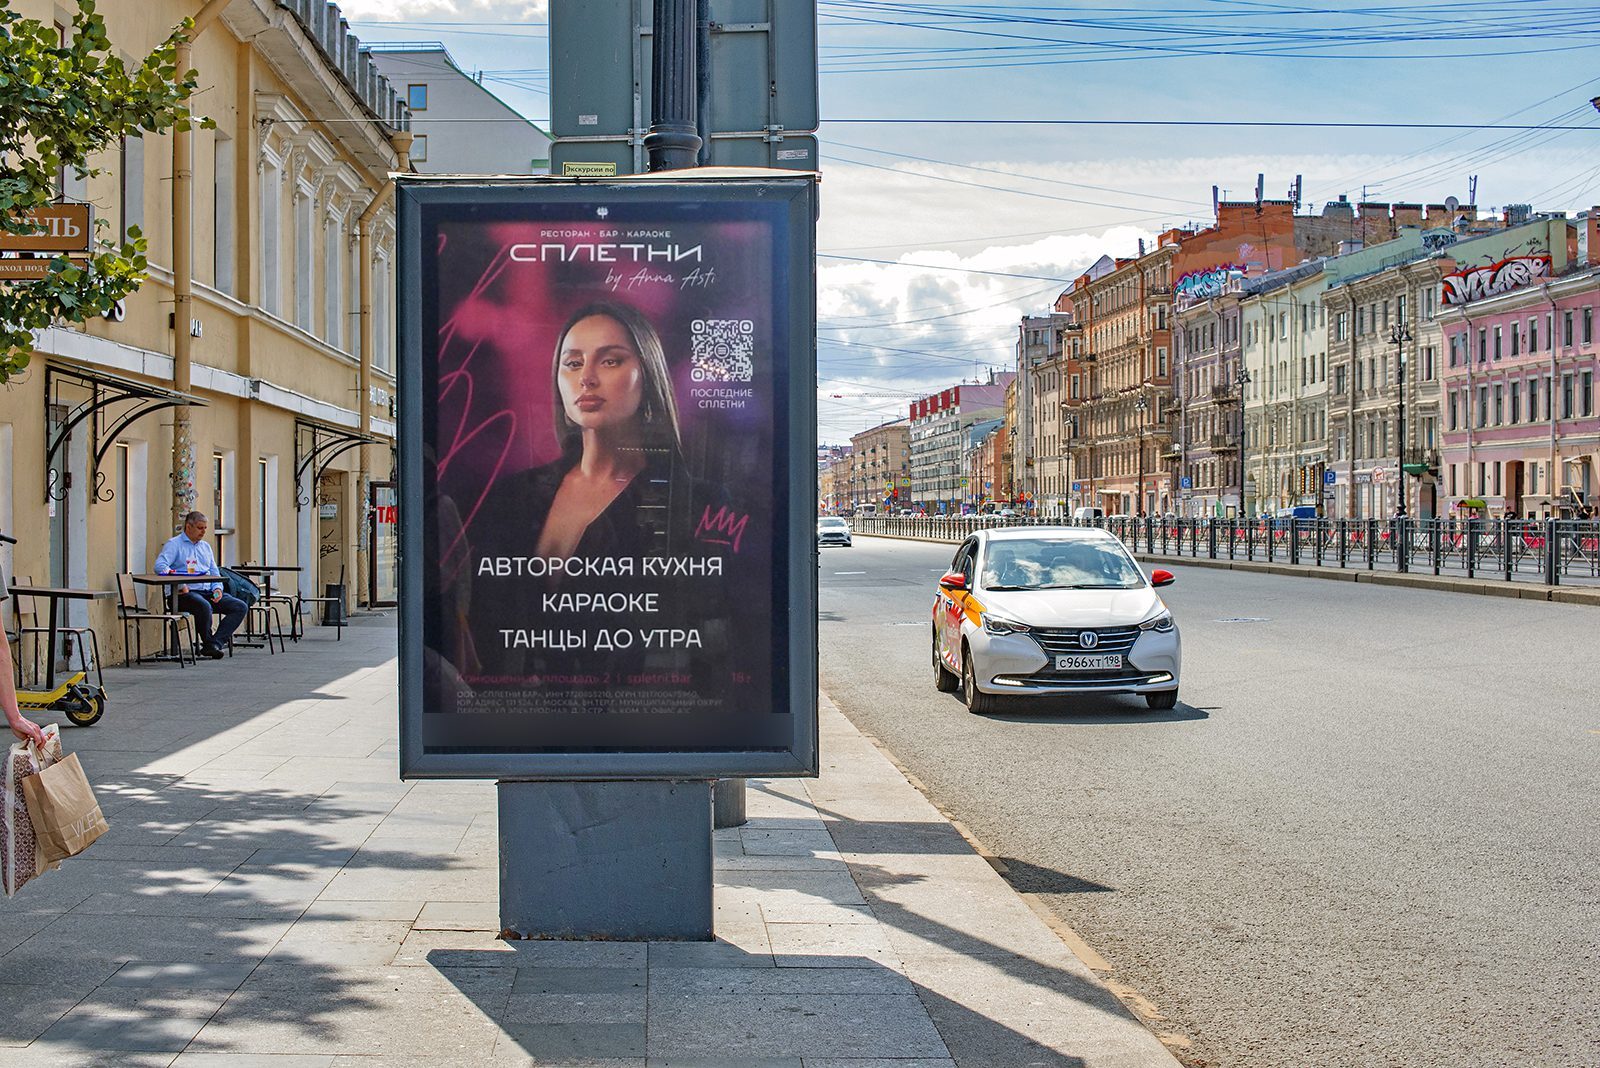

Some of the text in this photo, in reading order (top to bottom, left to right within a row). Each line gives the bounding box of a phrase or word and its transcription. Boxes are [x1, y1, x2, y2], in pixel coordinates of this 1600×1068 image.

[509, 244, 702, 262] СПЛЕТНИ
[605, 267, 716, 291] by Anna Asti
[690, 388, 753, 398] ПОСЛЕДНИЕ
[698, 400, 745, 408] СПЛЕТНИ
[478, 557, 722, 577] АВТОРСКАЯ КУХНЯ
[542, 593, 659, 612] КАРАОКЕ
[499, 629, 702, 650] ТАНЦЫ ДО УТРА
